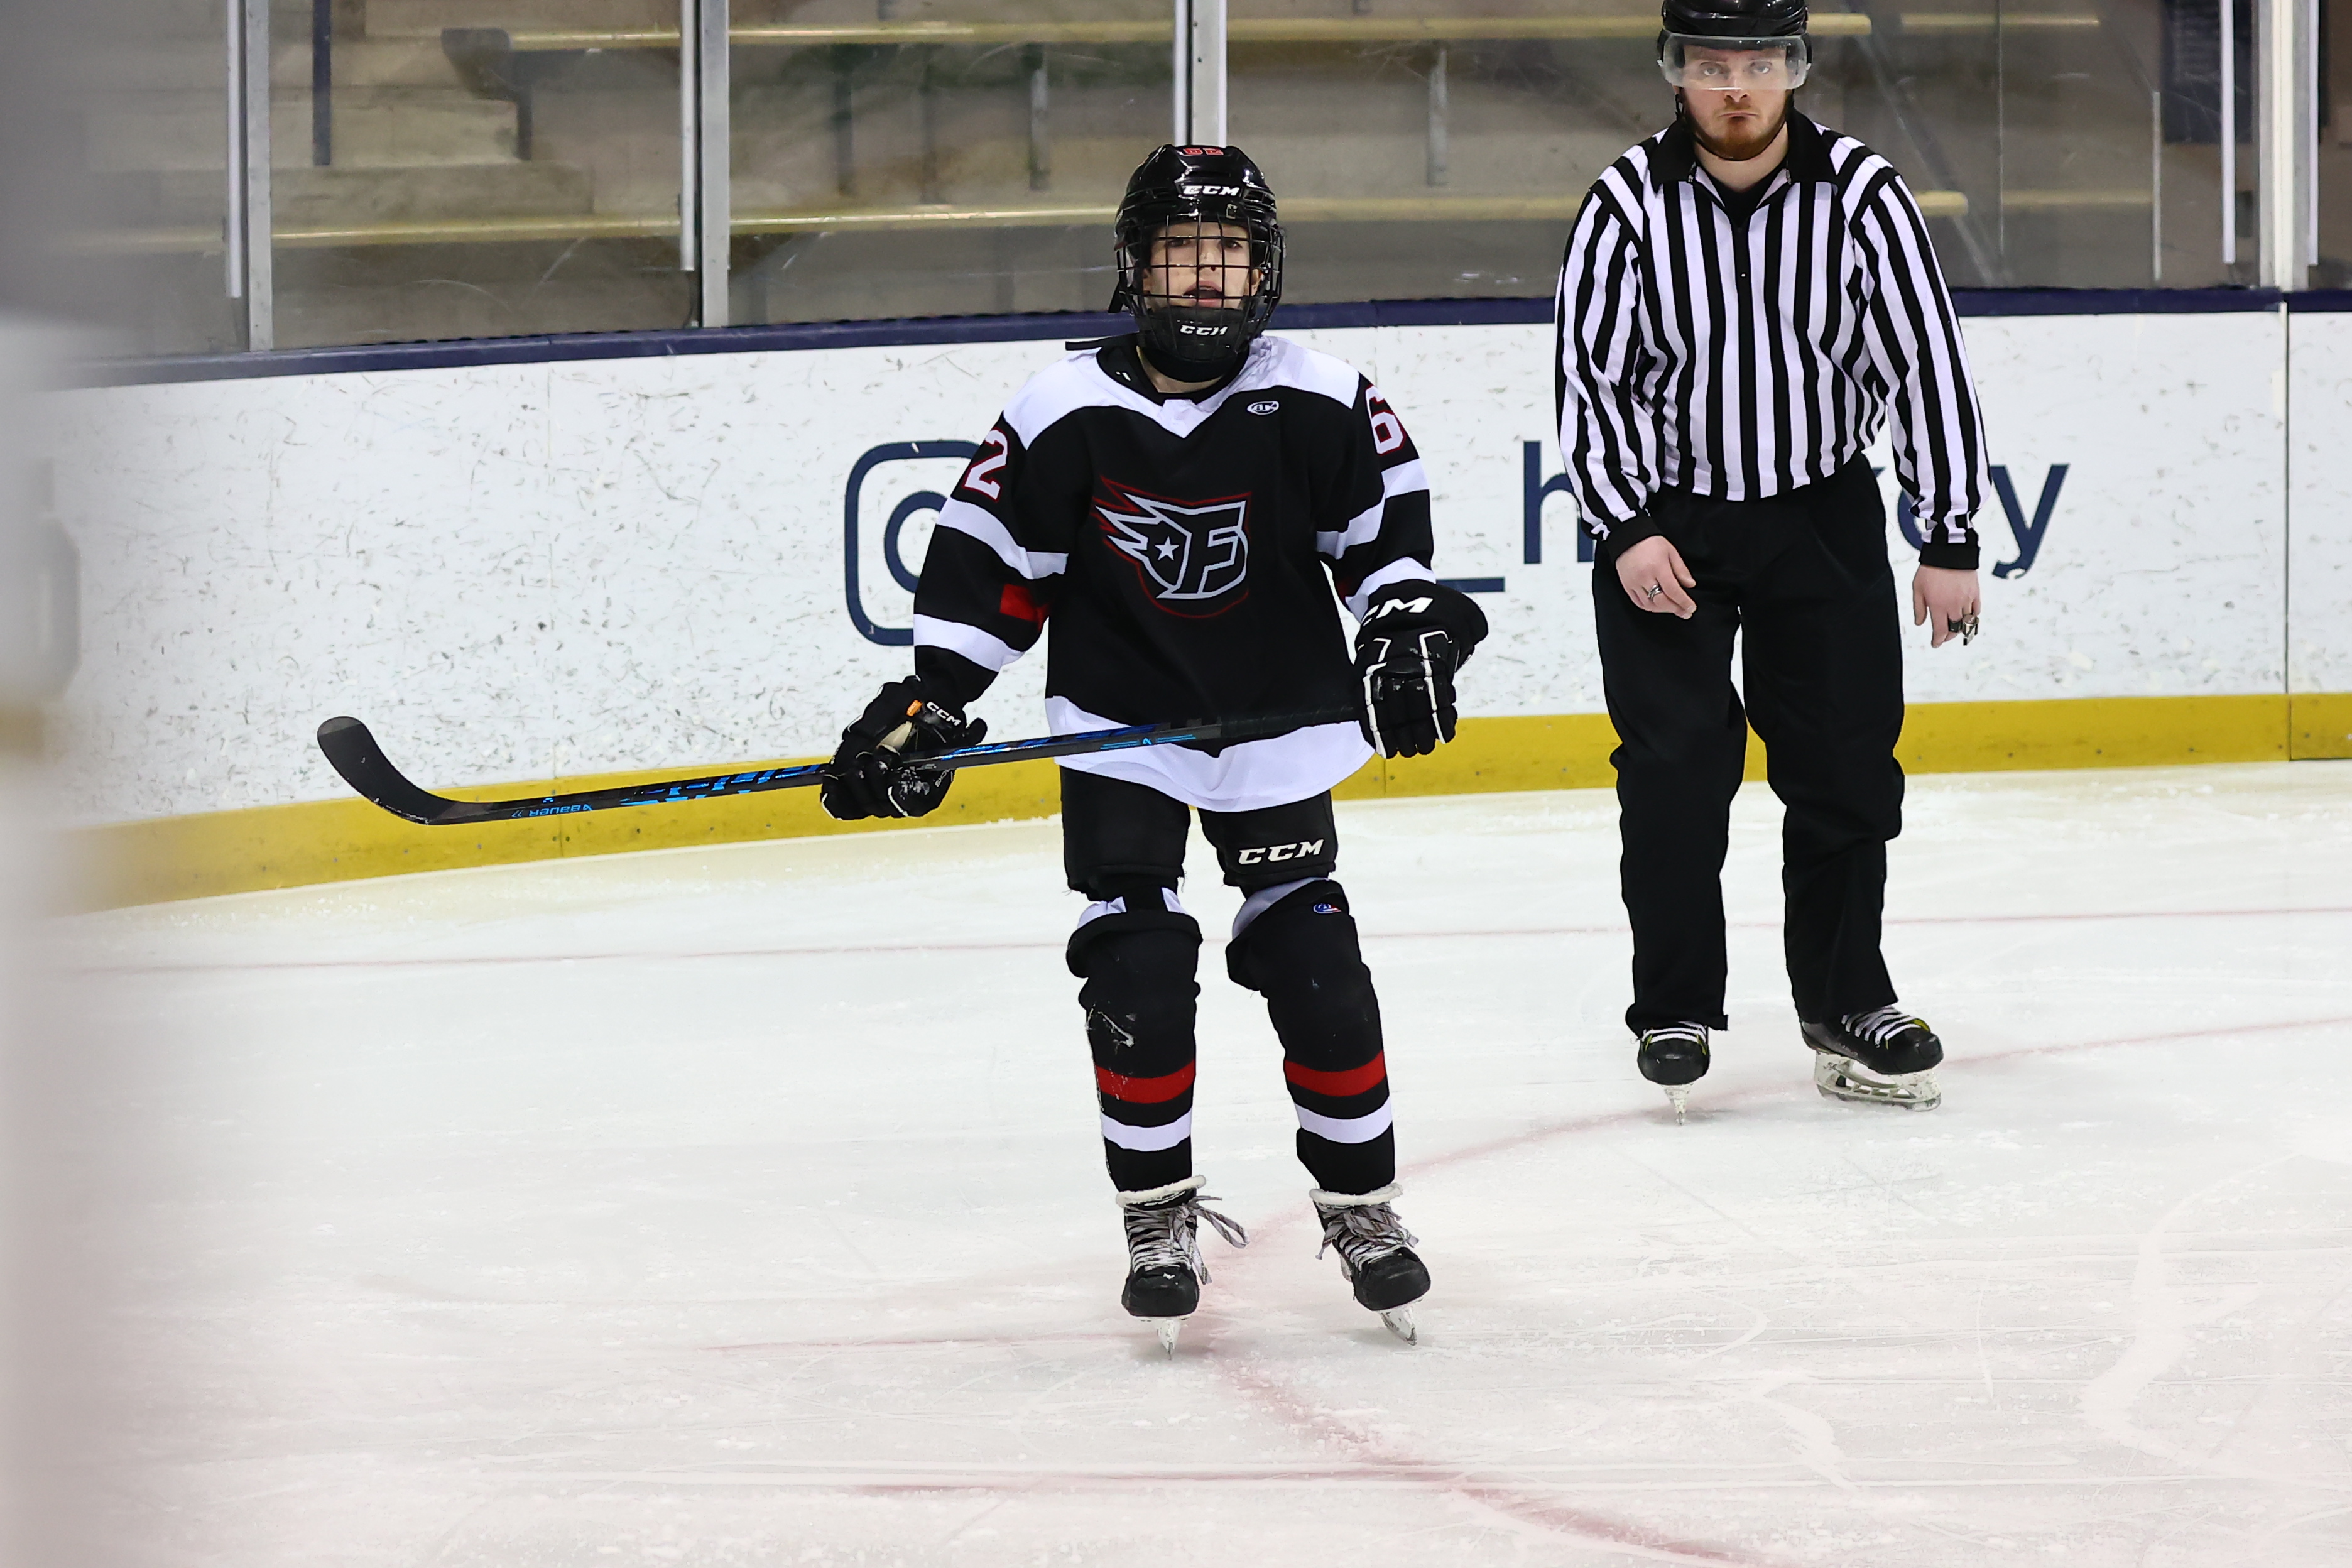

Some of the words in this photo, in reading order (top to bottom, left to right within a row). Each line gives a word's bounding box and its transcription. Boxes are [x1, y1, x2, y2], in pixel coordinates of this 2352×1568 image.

[1184, 185, 1239, 196] CCM
[926, 701, 962, 726] CCM
[1238, 839, 1324, 864] CCM
